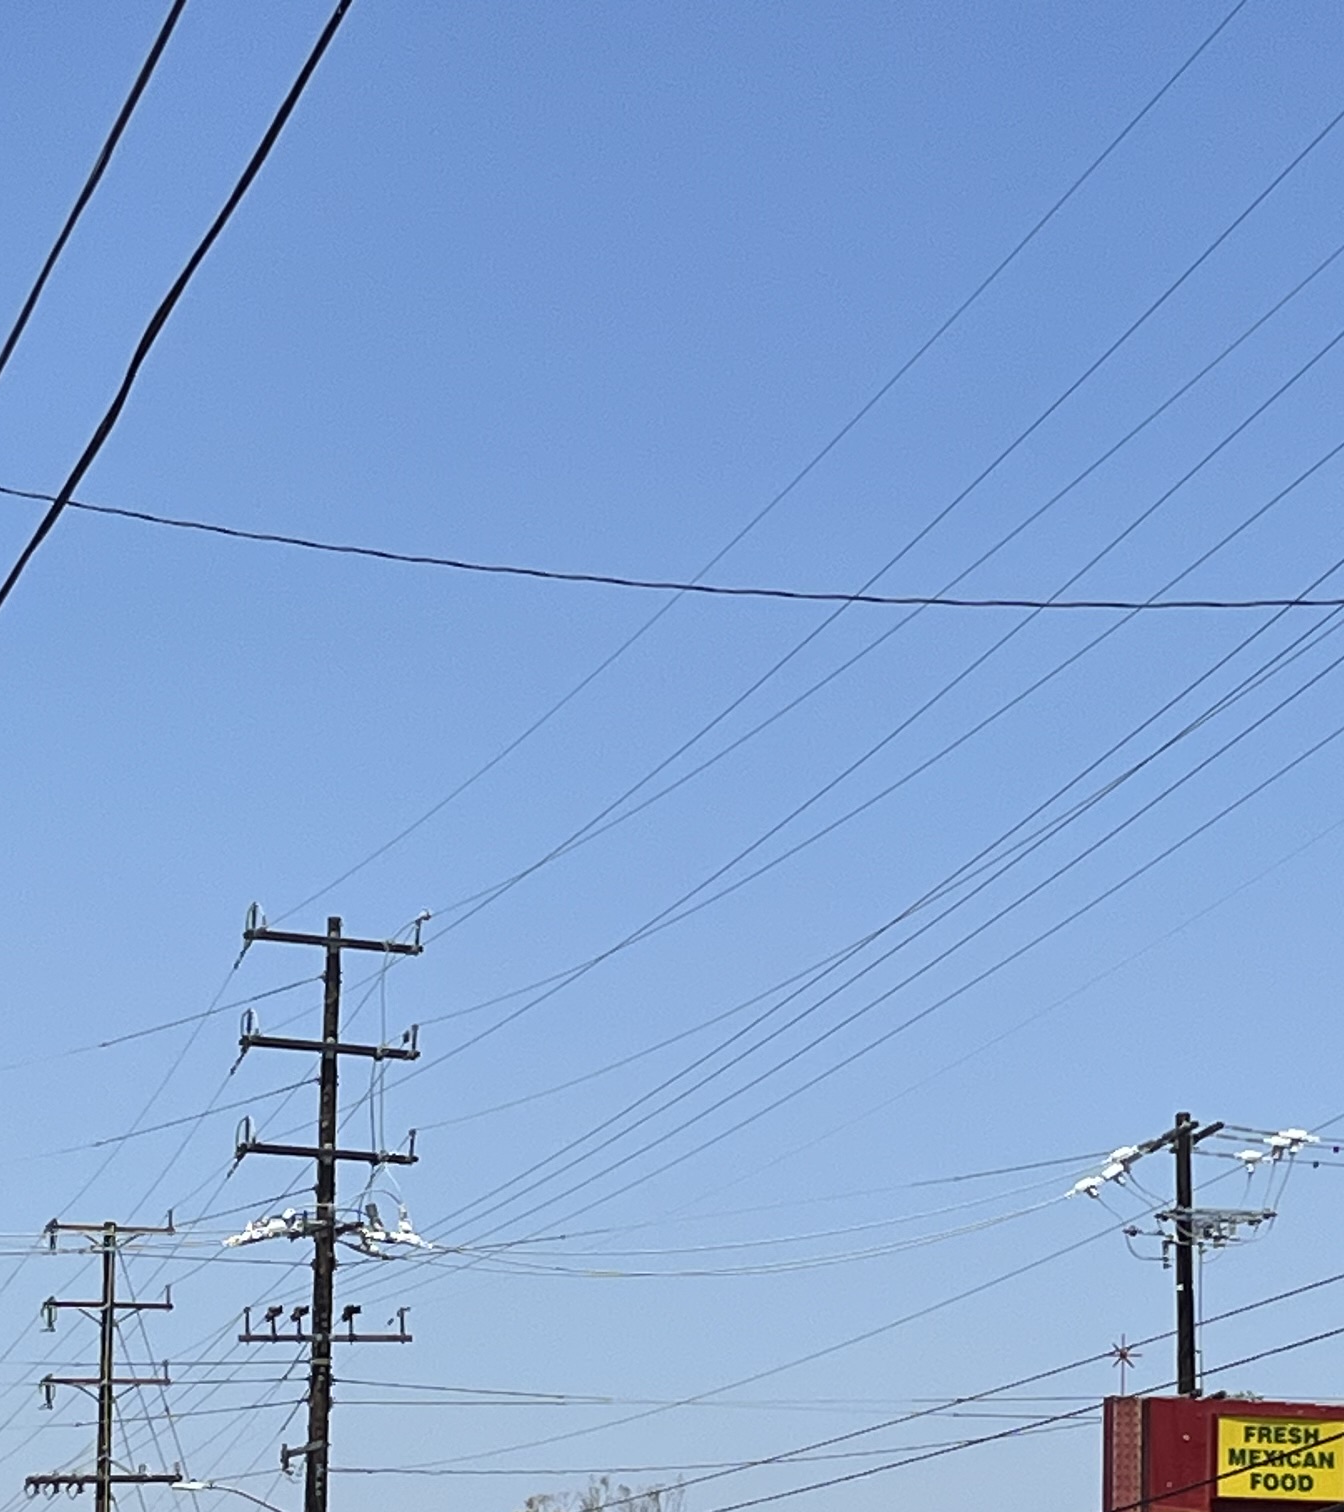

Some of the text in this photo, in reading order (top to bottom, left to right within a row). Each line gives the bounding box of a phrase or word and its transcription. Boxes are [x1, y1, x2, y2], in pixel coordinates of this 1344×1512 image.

[1244, 1426, 1320, 1444] FRESH
[1228, 1448, 1335, 1469] MEXICAN
[1250, 1472, 1314, 1492] FOOD
